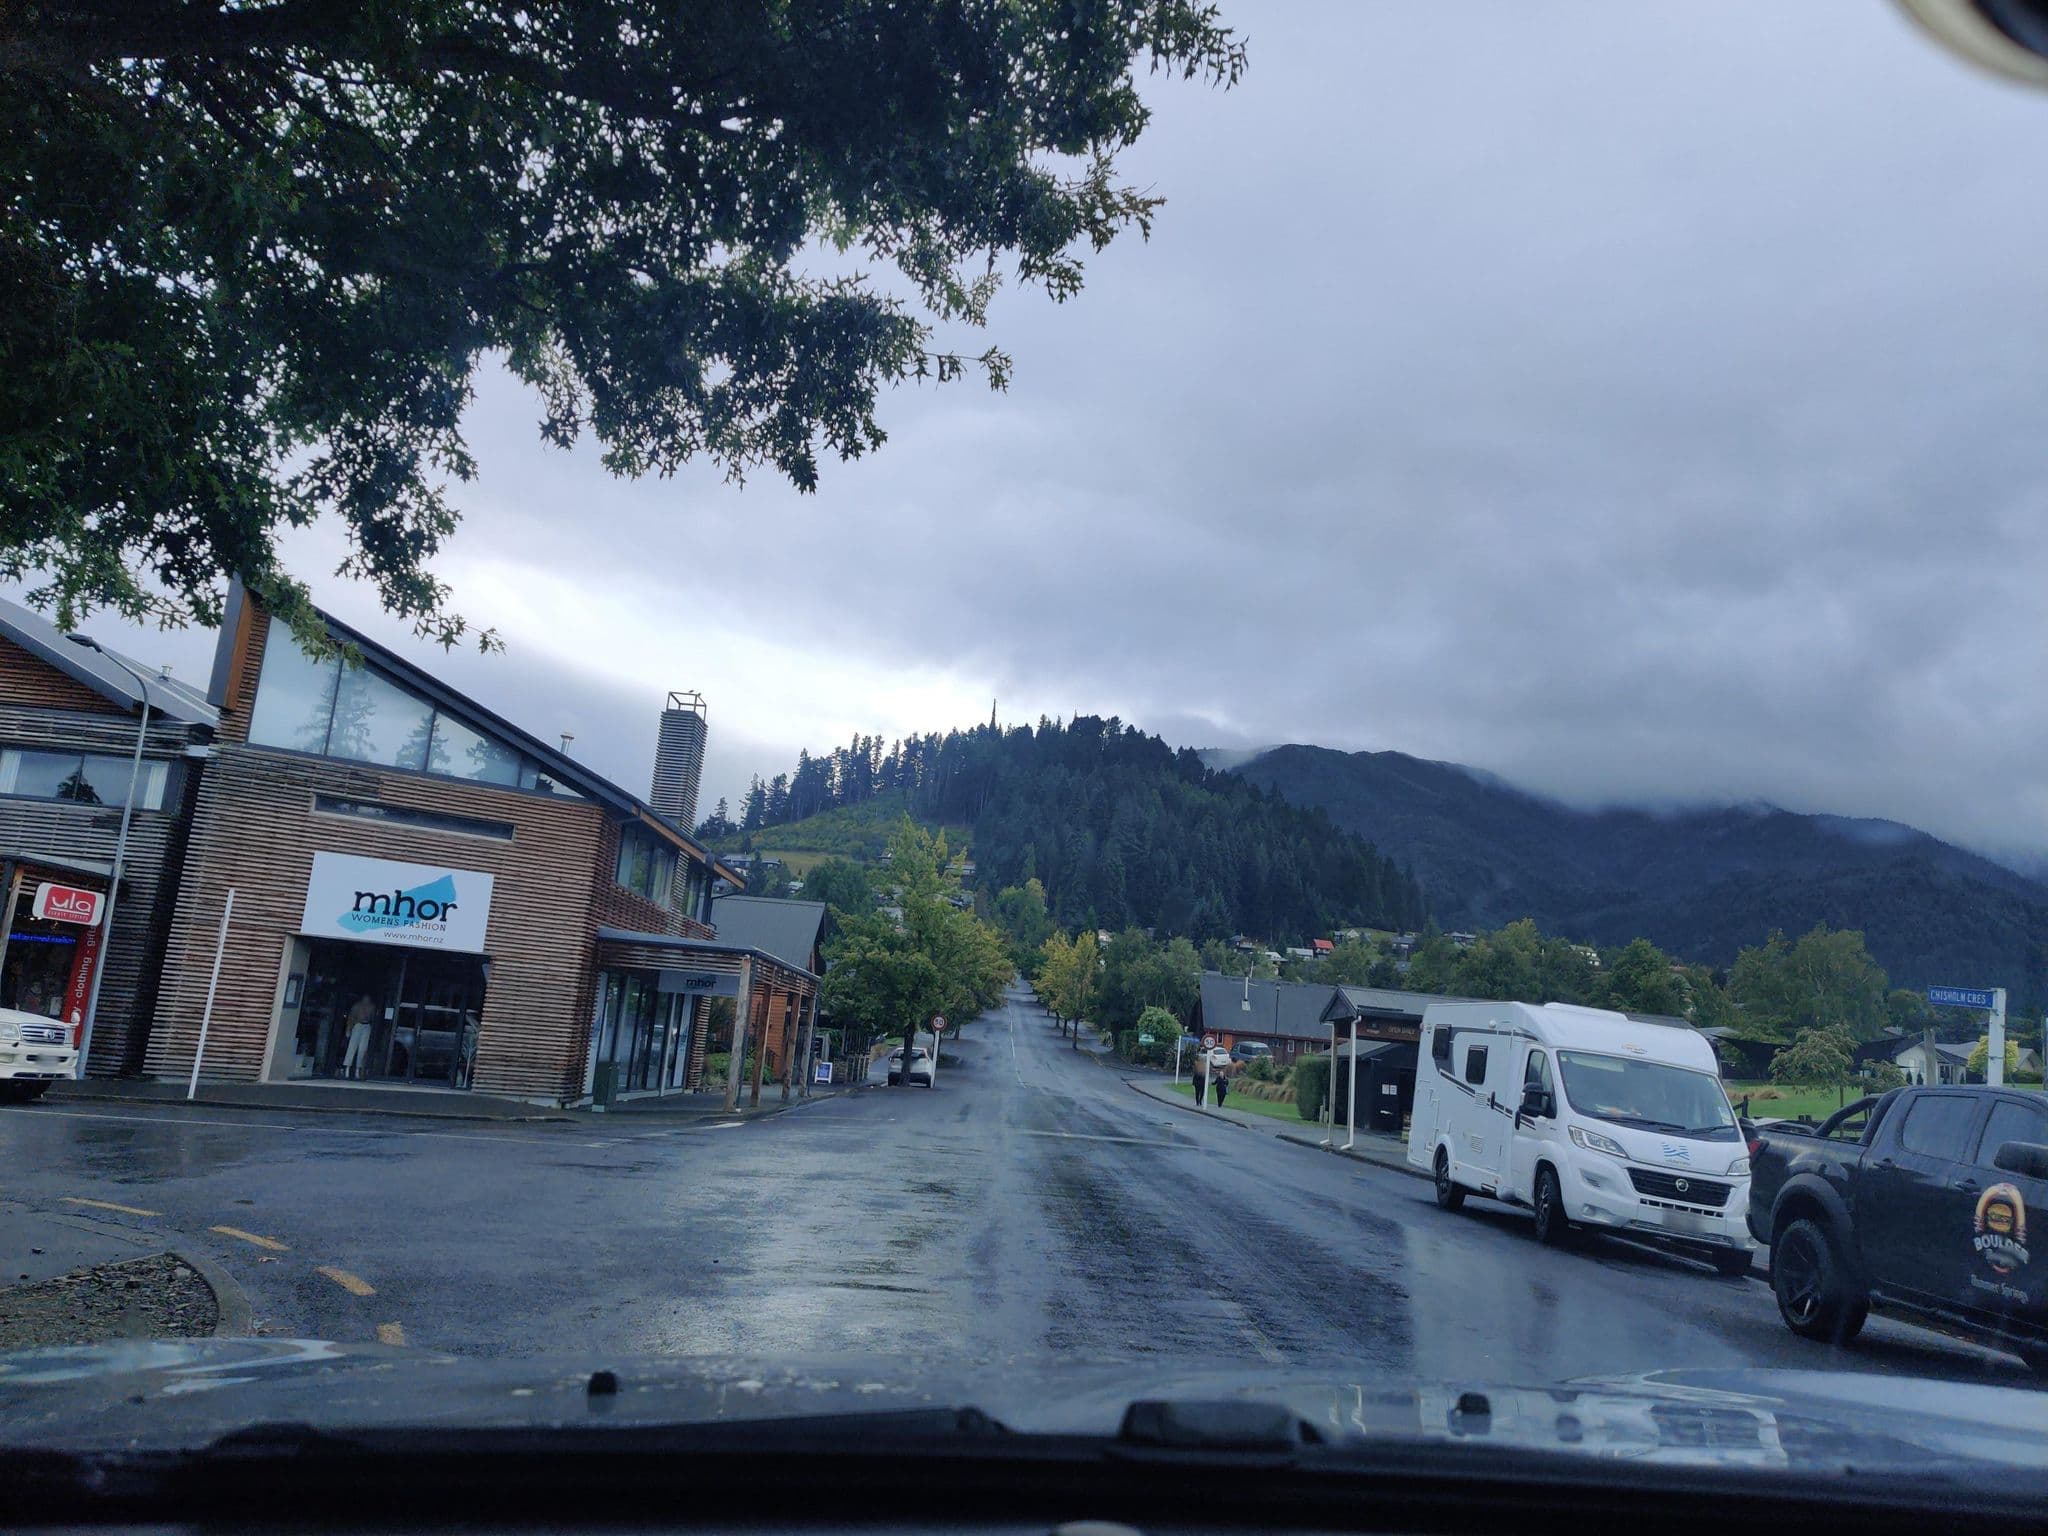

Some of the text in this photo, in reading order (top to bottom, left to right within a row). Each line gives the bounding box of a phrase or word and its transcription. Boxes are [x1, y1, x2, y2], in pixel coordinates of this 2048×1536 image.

[52, 893, 91, 912] ula
[352, 889, 458, 922] mhor
[352, 913, 447, 932] WOMENS FASHION
[383, 931, 445, 944] www.mhor.nz
[75, 956, 92, 998] clothing
[686, 978, 717, 989] mhor
[1967, 993, 1987, 1004] CRES
[934, 1018, 944, 1026] 50
